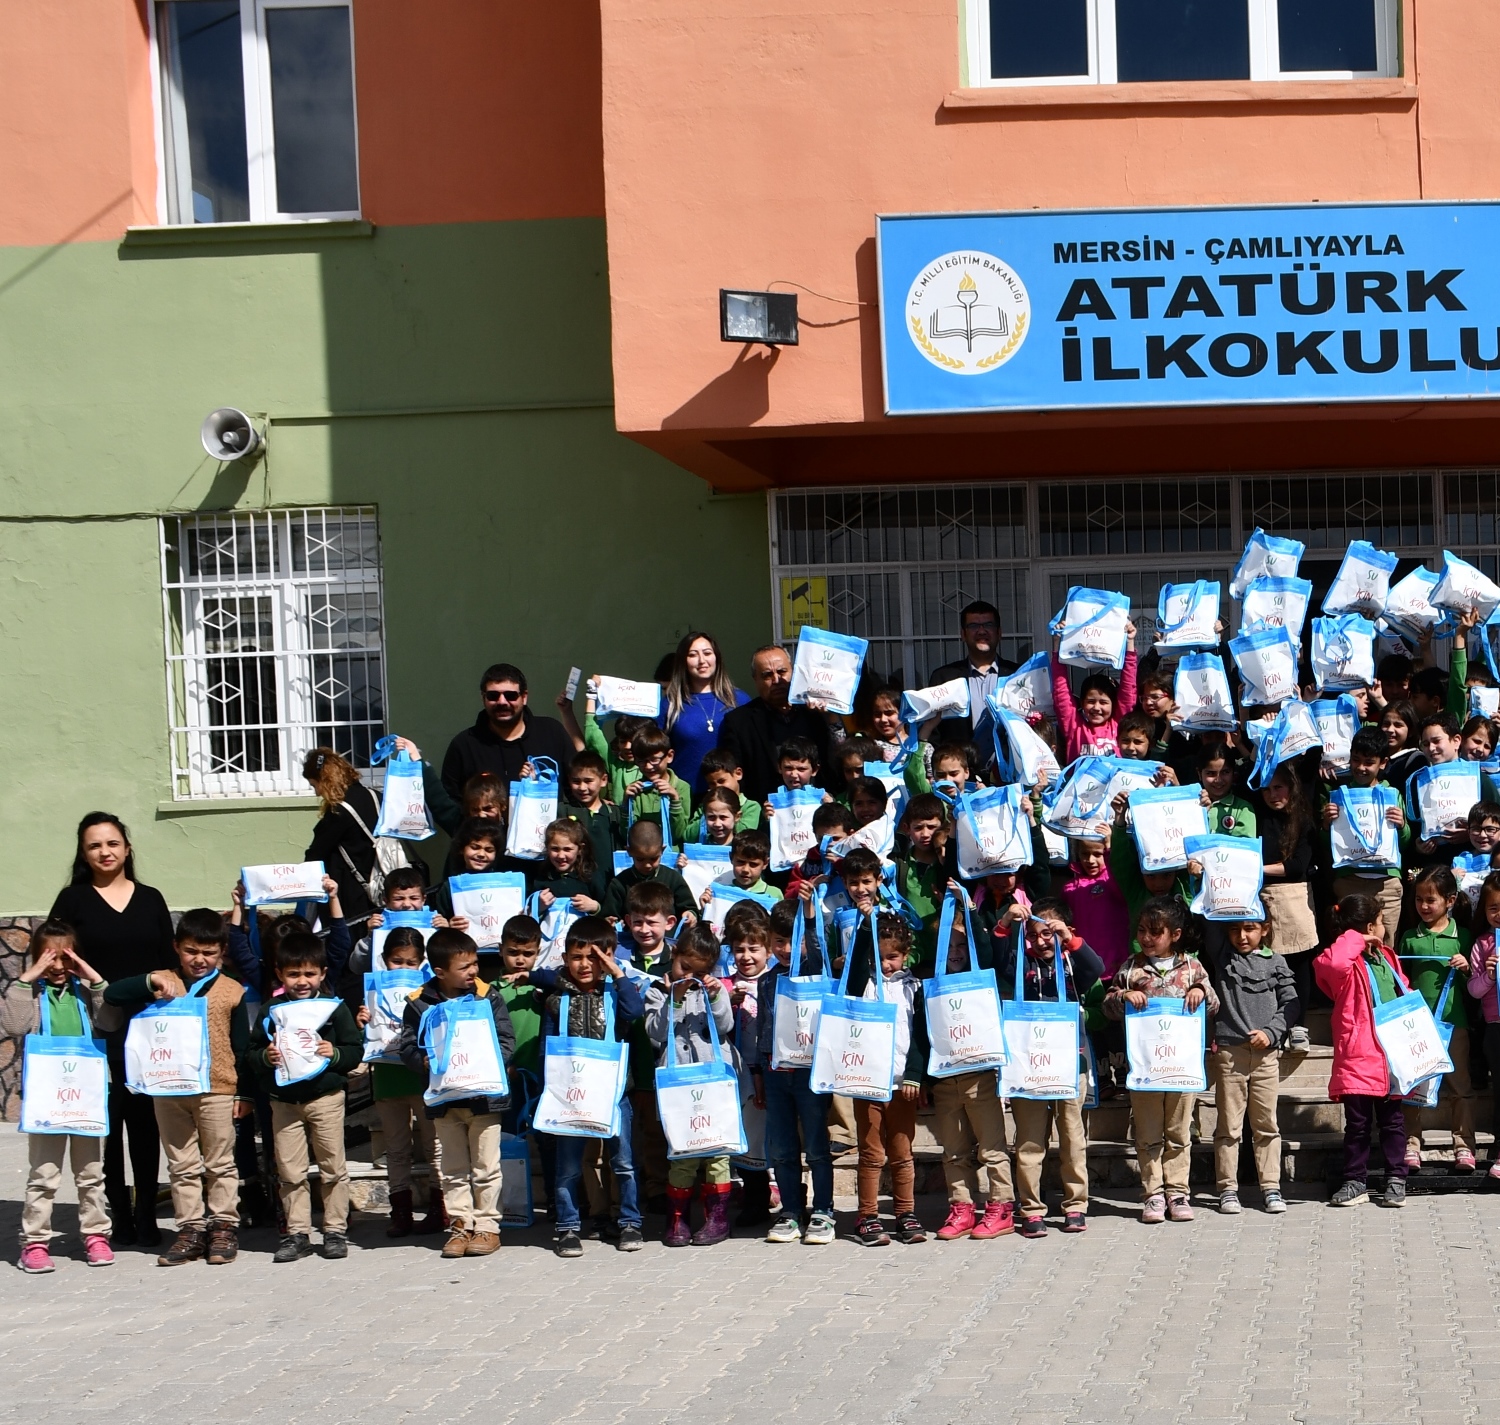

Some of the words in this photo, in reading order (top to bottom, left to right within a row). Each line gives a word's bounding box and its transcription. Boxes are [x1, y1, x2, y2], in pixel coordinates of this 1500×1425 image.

[1053, 234, 1176, 264] MERSİN
[1185, 248, 1195, 256] -
[1204, 233, 1405, 267] ÇAMLIYAYLA
[912, 290, 924, 306] T.C.
[921, 262, 944, 287] MİLLİ
[945, 255, 980, 268] EĞİTİM
[983, 259, 1024, 304] BAKANLIĞI
[1055, 263, 1466, 321] ATATÜRK
[1266, 555, 1278, 565] SU
[1367, 570, 1378, 580] SU
[1274, 596, 1282, 606] SU
[823, 650, 834, 660] SU
[1262, 652, 1270, 663] SU
[814, 671, 833, 683] İÇİN
[1264, 673, 1281, 688] İÇİN
[931, 687, 949, 701] İÇİN
[1318, 721, 1328, 730] SU
[1121, 776, 1132, 786] SU
[1439, 780, 1450, 790] SU
[541, 803, 550, 813] SU
[1162, 806, 1174, 816] SU
[1358, 808, 1368, 818] SU
[792, 810, 802, 819] SU
[790, 831, 809, 845] İÇİN
[1165, 828, 1183, 840] İÇİN
[1216, 851, 1229, 863] SU
[273, 866, 295, 878] İÇİN
[1210, 876, 1231, 891] İÇİN
[481, 893, 492, 903] SU
[481, 915, 498, 930] İÇİN
[949, 999, 962, 1011] SU
[796, 1006, 808, 1018] SU
[155, 1021, 168, 1034] SU
[1158, 1019, 1171, 1031] SU
[1403, 1018, 1415, 1031] SU
[850, 1025, 863, 1038] SU
[950, 1025, 972, 1042] İÇİN
[1034, 1026, 1046, 1039] SU
[1155, 1045, 1175, 1060] İÇİN
[1409, 1040, 1428, 1058] İÇİN
[150, 1047, 172, 1064] İÇİN
[842, 1051, 864, 1068] İÇİN
[1030, 1053, 1051, 1069] İÇİN
[62, 1061, 77, 1073] SU
[572, 1061, 585, 1073] SU
[57, 1087, 81, 1104] İÇİN
[566, 1087, 586, 1104] İÇİN
[691, 1090, 704, 1102] SU
[690, 1116, 710, 1132] İÇİN
